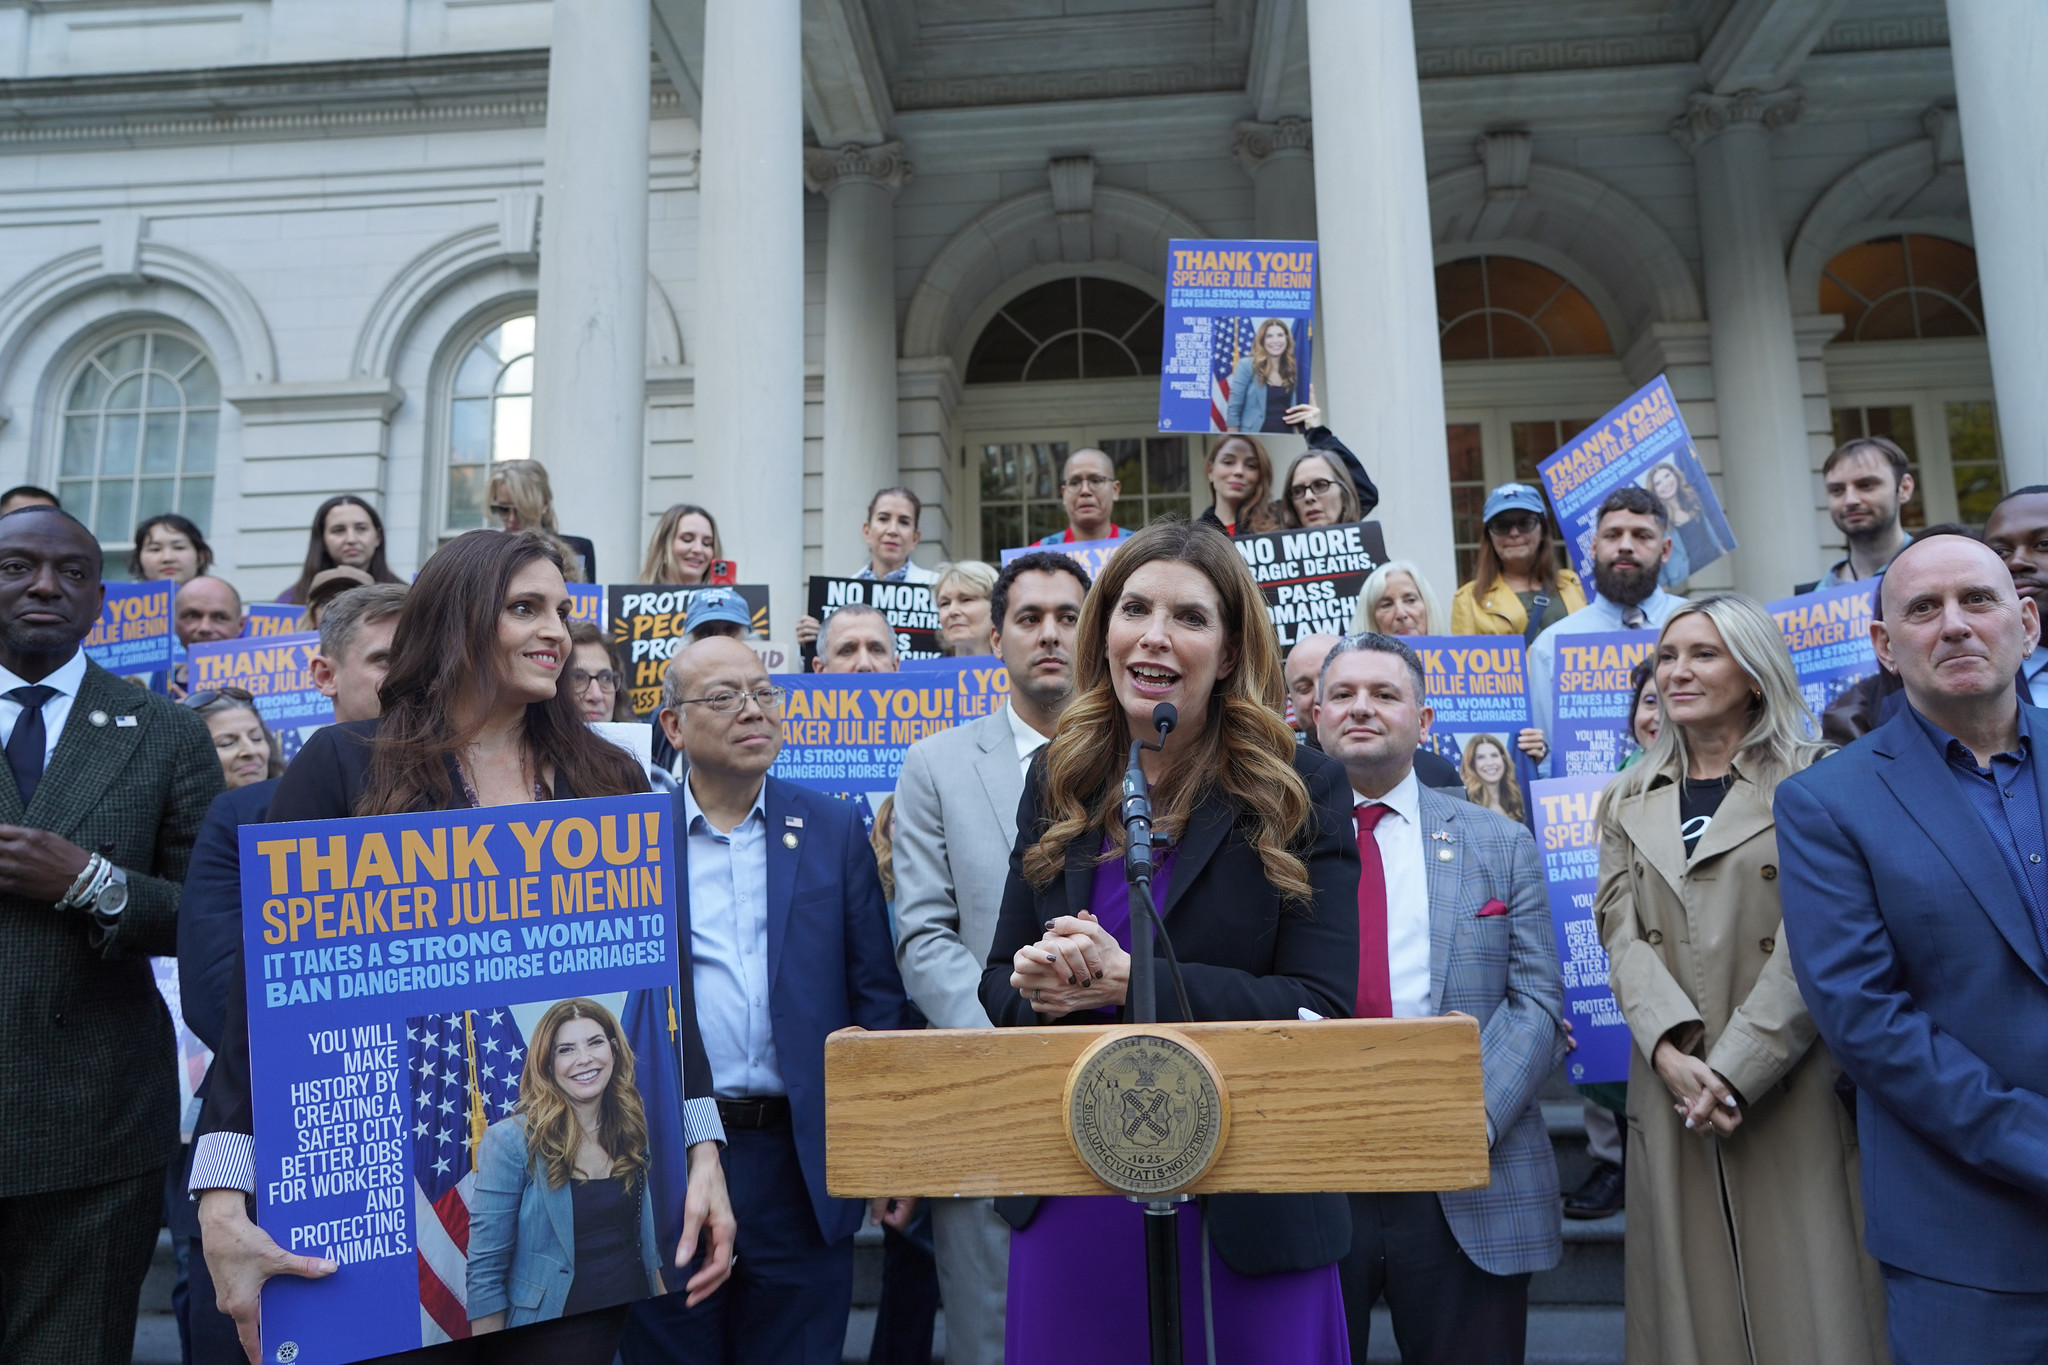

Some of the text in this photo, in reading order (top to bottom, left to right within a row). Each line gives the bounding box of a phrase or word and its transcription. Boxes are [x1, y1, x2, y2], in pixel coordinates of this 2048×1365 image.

[1173, 251, 1313, 272] THANK YOU!
[1172, 270, 1311, 289] SPEAKER JULIE MENIN
[1171, 288, 1180, 298] IT
[1181, 289, 1204, 298] TAKES
[1212, 289, 1254, 299] STRONG
[1257, 290, 1298, 300] WOMAN
[1301, 291, 1311, 300] TO
[1171, 299, 1193, 308] BAN
[1545, 386, 1668, 485] THANK YOU!
[1552, 404, 1675, 500] SPEAKER JULIE MENIN
[1235, 527, 1364, 565] NO MORE
[1303, 552, 1377, 577] DEATHS,
[827, 580, 865, 607] NO
[1277, 580, 1336, 605] PASS
[107, 592, 168, 623] YOU!
[1773, 592, 1873, 635] THANK
[122, 616, 168, 641] MENIN
[195, 647, 298, 681] THANK
[1448, 648, 1521, 674] YOU!
[1469, 674, 1524, 694] MENIN
[869, 688, 953, 719] YOU!
[1456, 697, 1511, 709] WOMAN
[1512, 696, 1526, 709] TO
[1559, 695, 1569, 706] IT
[1570, 694, 1602, 706] TAKES
[1603, 694, 1611, 705] A
[1559, 706, 1588, 719] BAN
[1436, 709, 1527, 722] HORSE CARRIAGES!
[835, 720, 886, 745] JULIE
[1575, 729, 1616, 742] YOU WILL
[792, 749, 802, 763] A
[803, 748, 869, 764] STRONG
[1565, 750, 1616, 762] HISTORY BY
[1589, 740, 1616, 751] MAKE
[777, 764, 846, 779] DANGEROUS
[848, 764, 886, 779] HORSE
[1566, 761, 1616, 772] CREATING A
[256, 811, 660, 895] THANK YOU!
[1546, 848, 1598, 868] IT TAKES
[1548, 864, 1583, 882] BAN
[262, 865, 663, 945] SPEAKER JULIE MENIN
[1571, 893, 1593, 908] YOU
[263, 913, 665, 980] IT TAKES A STRONG WOMAN TO
[1570, 945, 1604, 961] SAFER
[265, 939, 666, 1008] BAN DANGEROUS HORSE CARRIAGES!
[1563, 959, 1602, 974] BETTER
[308, 1023, 398, 1055] YOU WILL
[344, 1046, 398, 1075] MAKE
[290, 1068, 400, 1106] HISTORY BY
[294, 1092, 402, 1130] CREATING A
[298, 1115, 408, 1153] SAFER CITY,
[1104, 1154, 1166, 1180] CIVITATIS
[1166, 1152, 1194, 1175] NOVI
[1191, 1105, 1209, 1152] EBORACI
[281, 1138, 403, 1180] BETTER JOBS
[1132, 1154, 1161, 1164] 1625
[268, 1162, 404, 1205] FOR WORKERS
[366, 1185, 405, 1213] AND
[290, 1208, 406, 1250] PROTECTING
[323, 1232, 413, 1267] ANIMALS.
